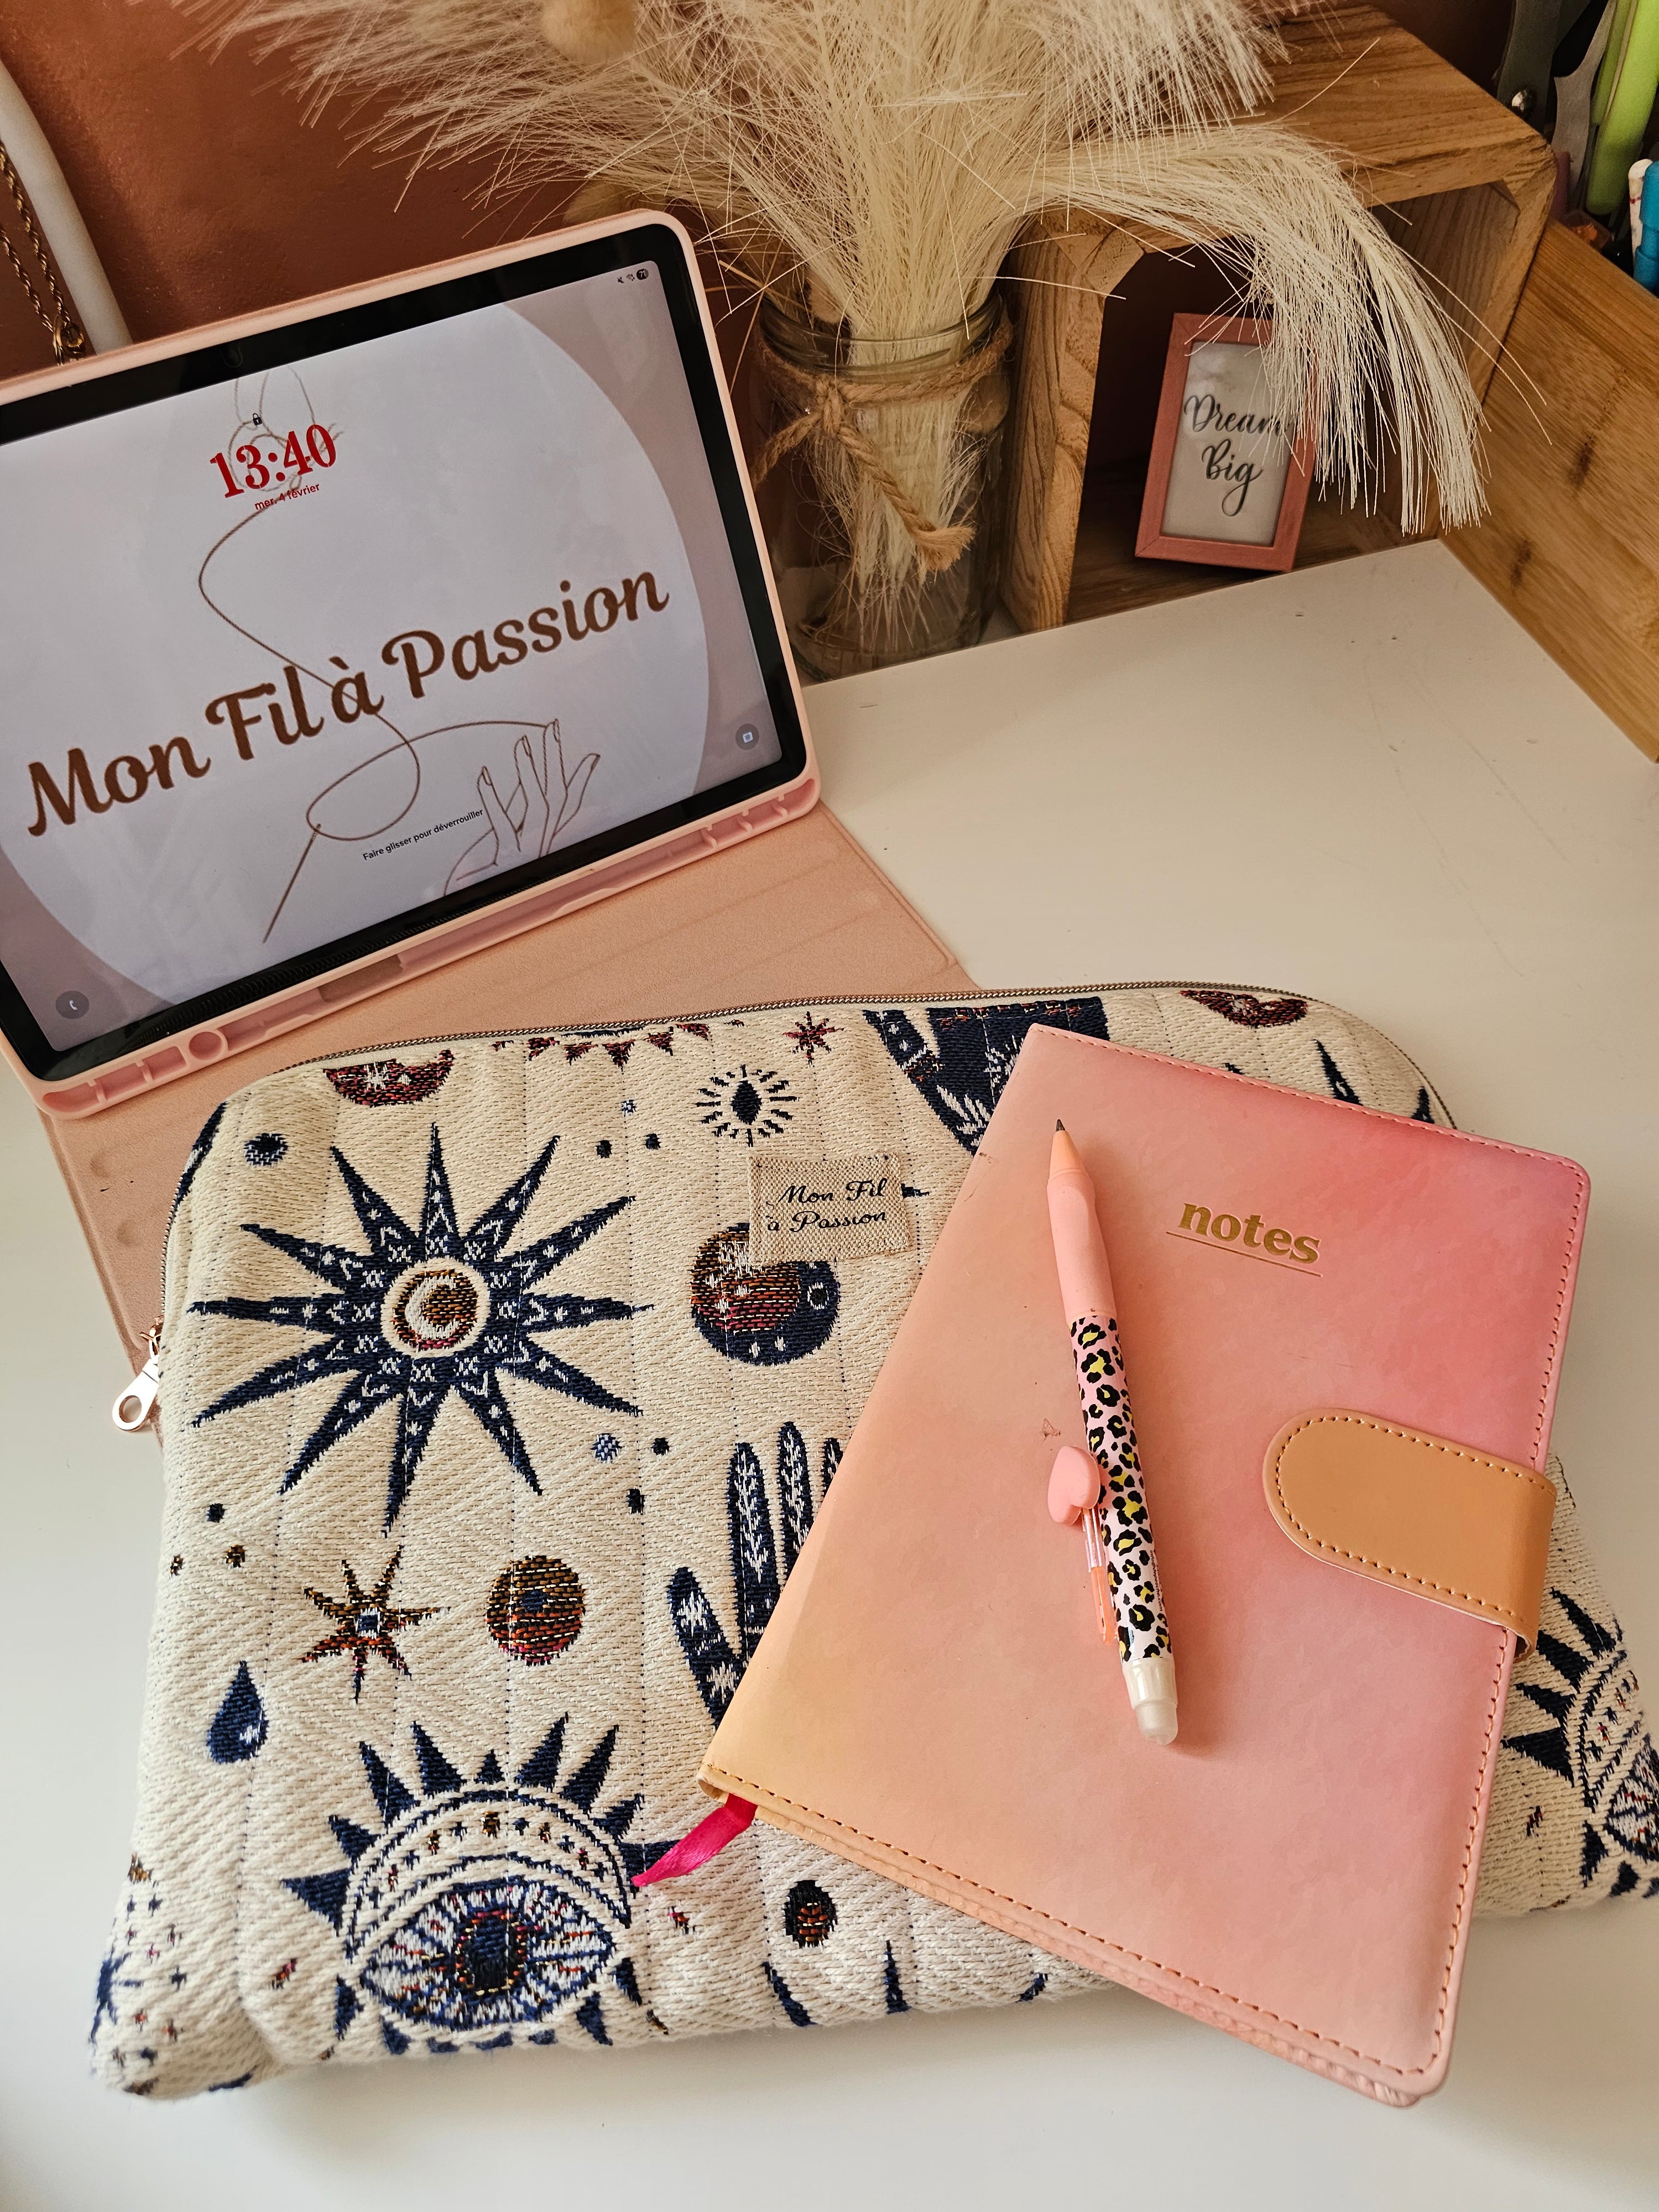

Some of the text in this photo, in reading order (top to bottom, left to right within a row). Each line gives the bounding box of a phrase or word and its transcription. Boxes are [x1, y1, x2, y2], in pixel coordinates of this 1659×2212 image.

[1184, 394, 1291, 437] Dream
[210, 424, 336, 498] 13:40
[1201, 439, 1264, 517] Big
[254, 483, 321, 510] mer. 4 février
[27, 572, 669, 837] Mon Fil à Passion
[363, 810, 483, 860] Faire glisser pour déverrouiller
[766, 1177, 888, 1206] Mon Fil
[789, 1211, 887, 1233] Passion
[1178, 1202, 1321, 1264] notes
